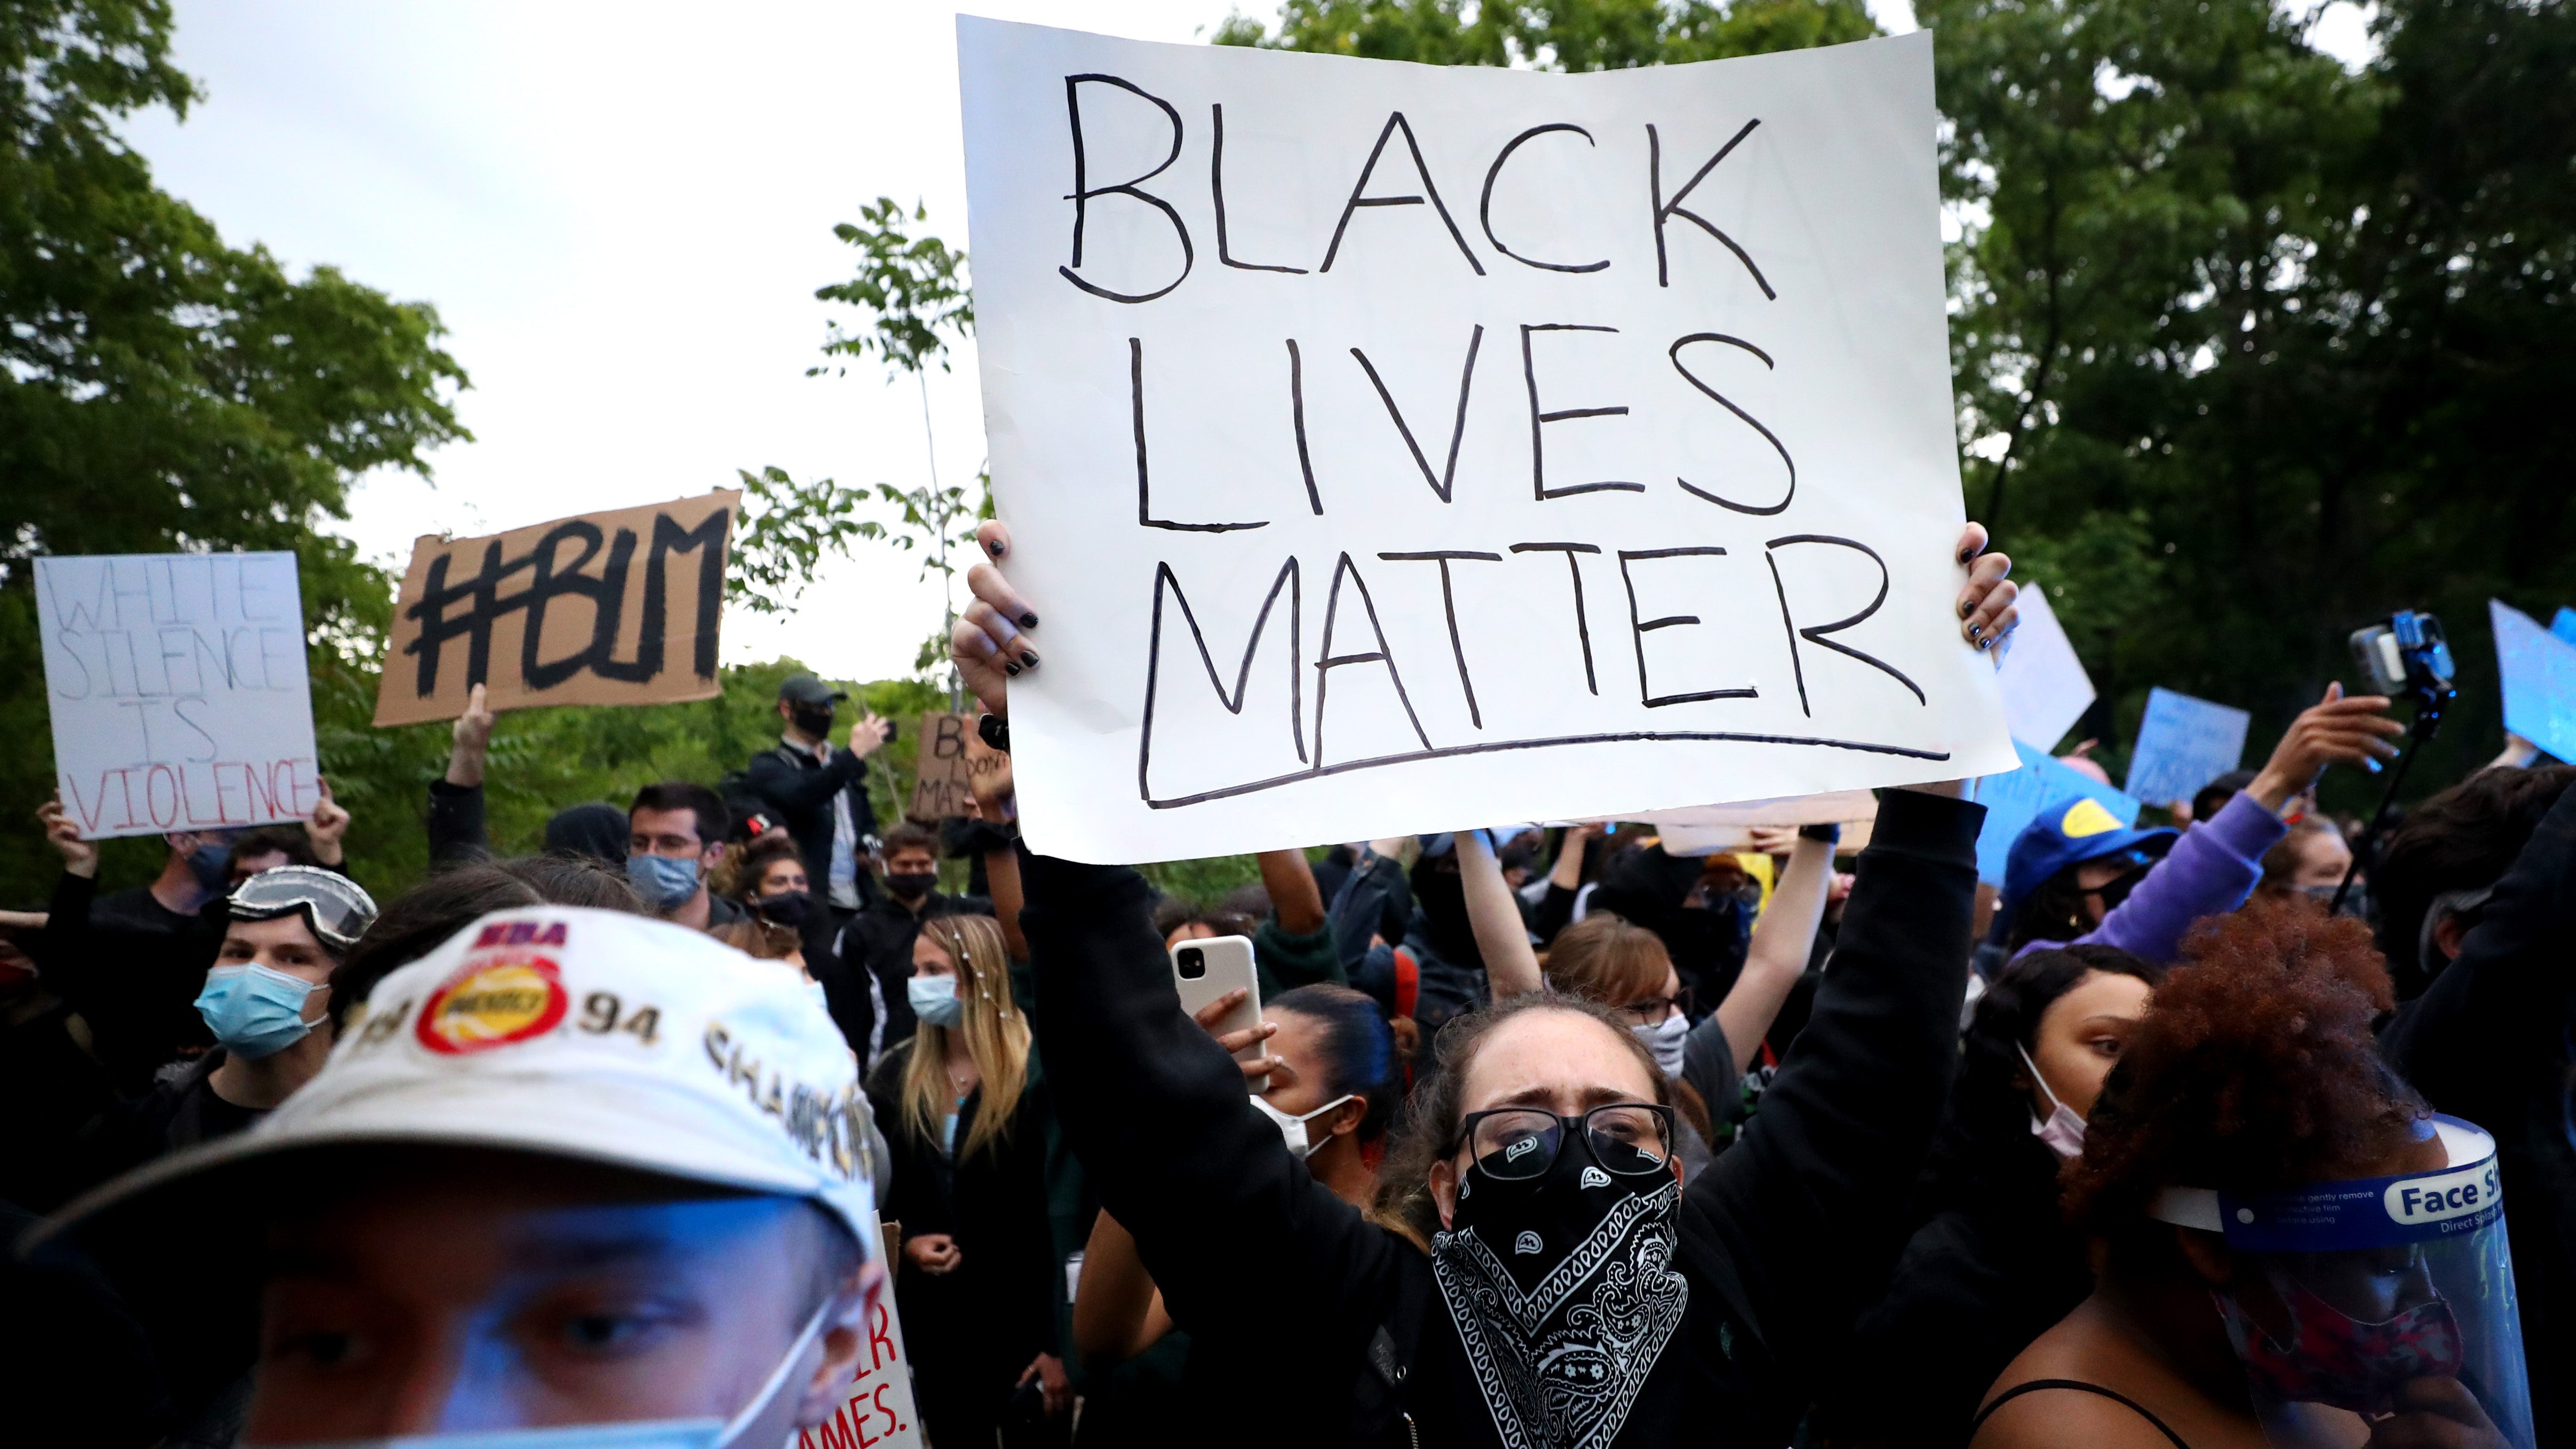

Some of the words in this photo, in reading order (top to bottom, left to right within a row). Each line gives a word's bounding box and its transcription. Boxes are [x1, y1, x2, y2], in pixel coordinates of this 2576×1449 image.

[1059, 73, 1778, 305] BLACK
[1128, 324, 1796, 533] LIVES
[42, 557, 283, 633] WHITE
[403, 506, 729, 698] #BLM
[56, 627, 296, 700] SILENCE
[1138, 534, 1927, 795] MATTER
[117, 694, 218, 767] IS
[66, 757, 315, 834] VIOLENCE
[577, 990, 663, 1045] 94
[2339, 1190, 2374, 1200] remove
[2402, 1184, 2478, 1216] Face
[2440, 1220, 2472, 1233] Direct
